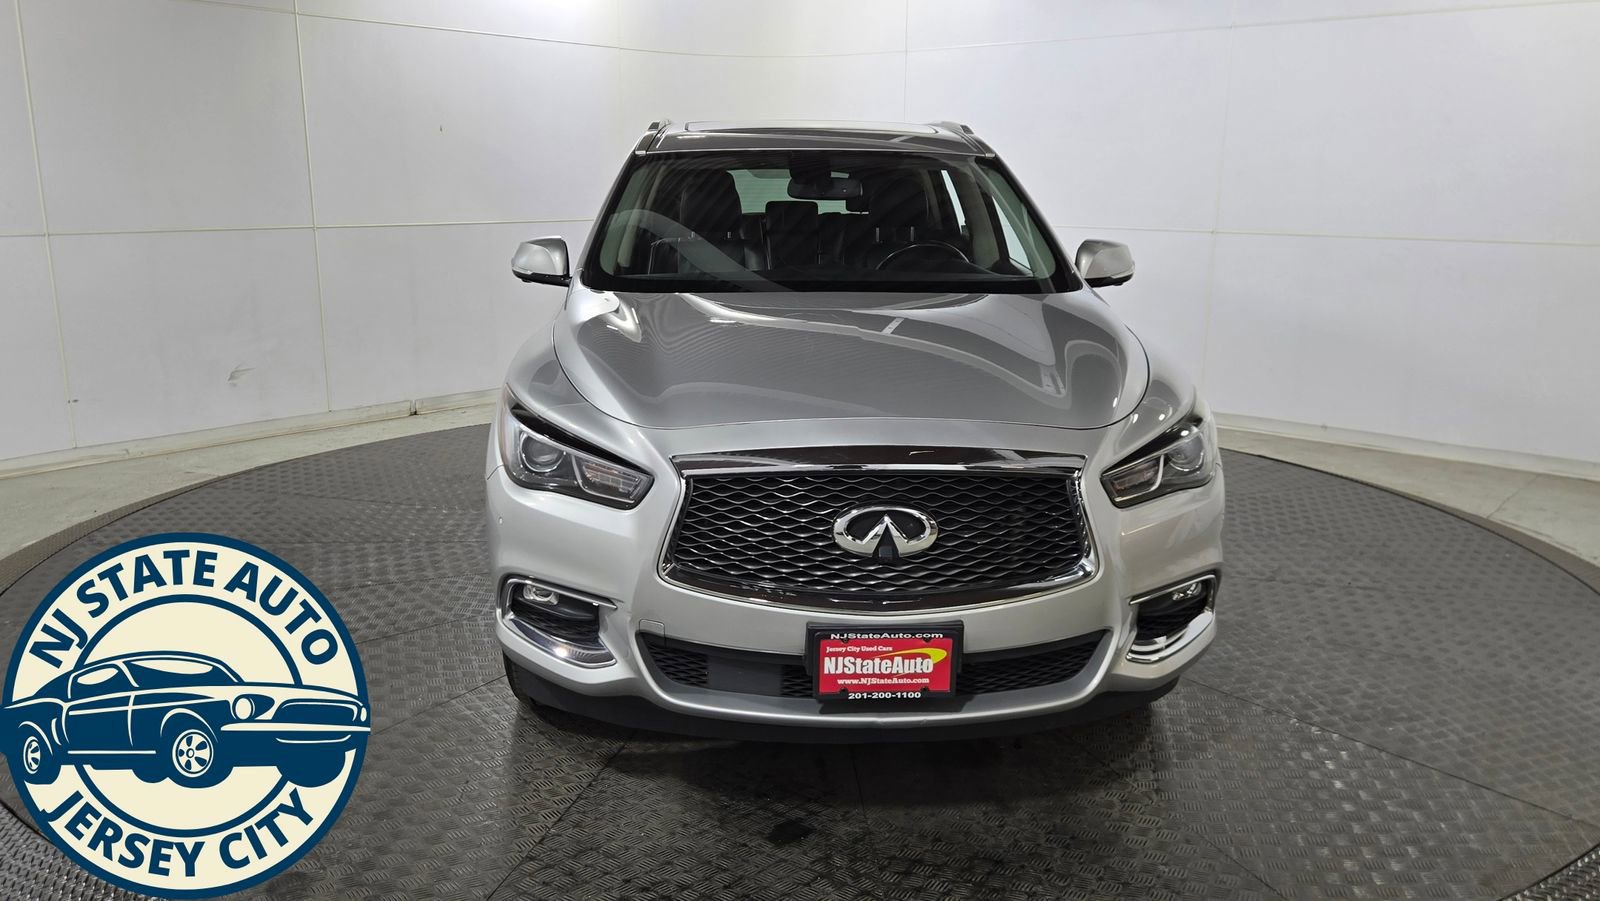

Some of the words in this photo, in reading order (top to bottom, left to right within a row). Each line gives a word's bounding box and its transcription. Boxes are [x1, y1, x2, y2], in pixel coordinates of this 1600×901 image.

[826, 646, 847, 654] Jersey
[824, 656, 934, 675] NJStateAuto
[837, 677, 930, 685] www.NJStateAuto.com
[848, 692, 922, 700] 201-200-1100
